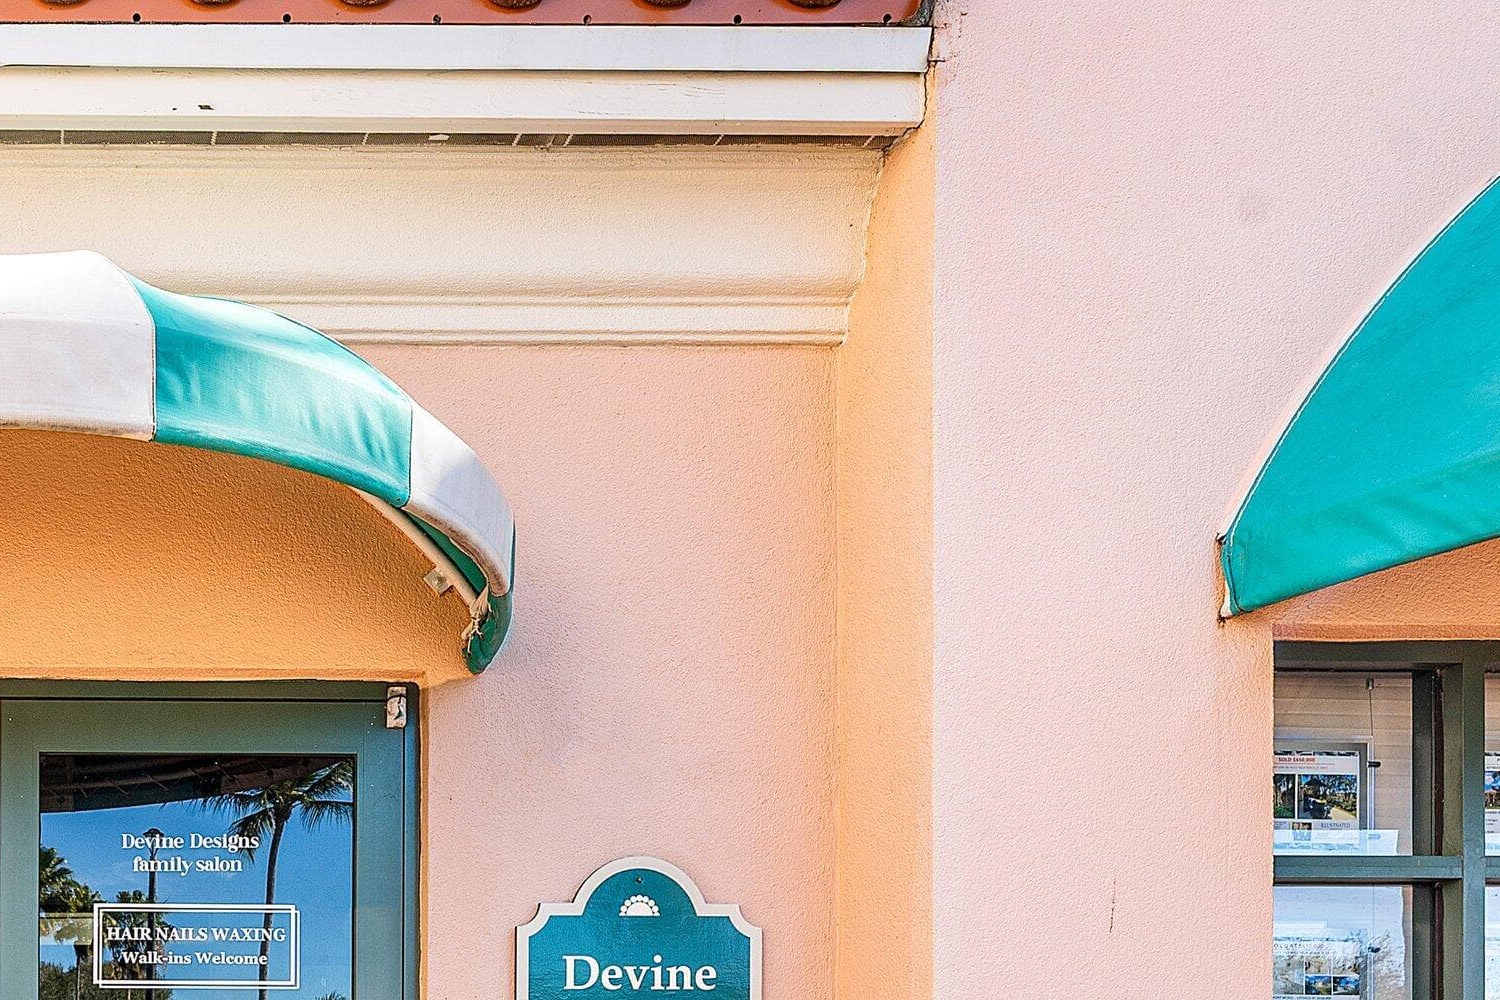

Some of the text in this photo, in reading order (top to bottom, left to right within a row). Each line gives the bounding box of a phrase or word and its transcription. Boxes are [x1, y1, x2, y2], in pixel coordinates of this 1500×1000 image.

[121, 833, 260, 852] Devine Designs
[132, 856, 243, 877] family salon
[106, 926, 287, 942] HAIR NAILS WAXING
[121, 951, 268, 965] Walk-ins Welcome
[562, 954, 718, 991] Devine
